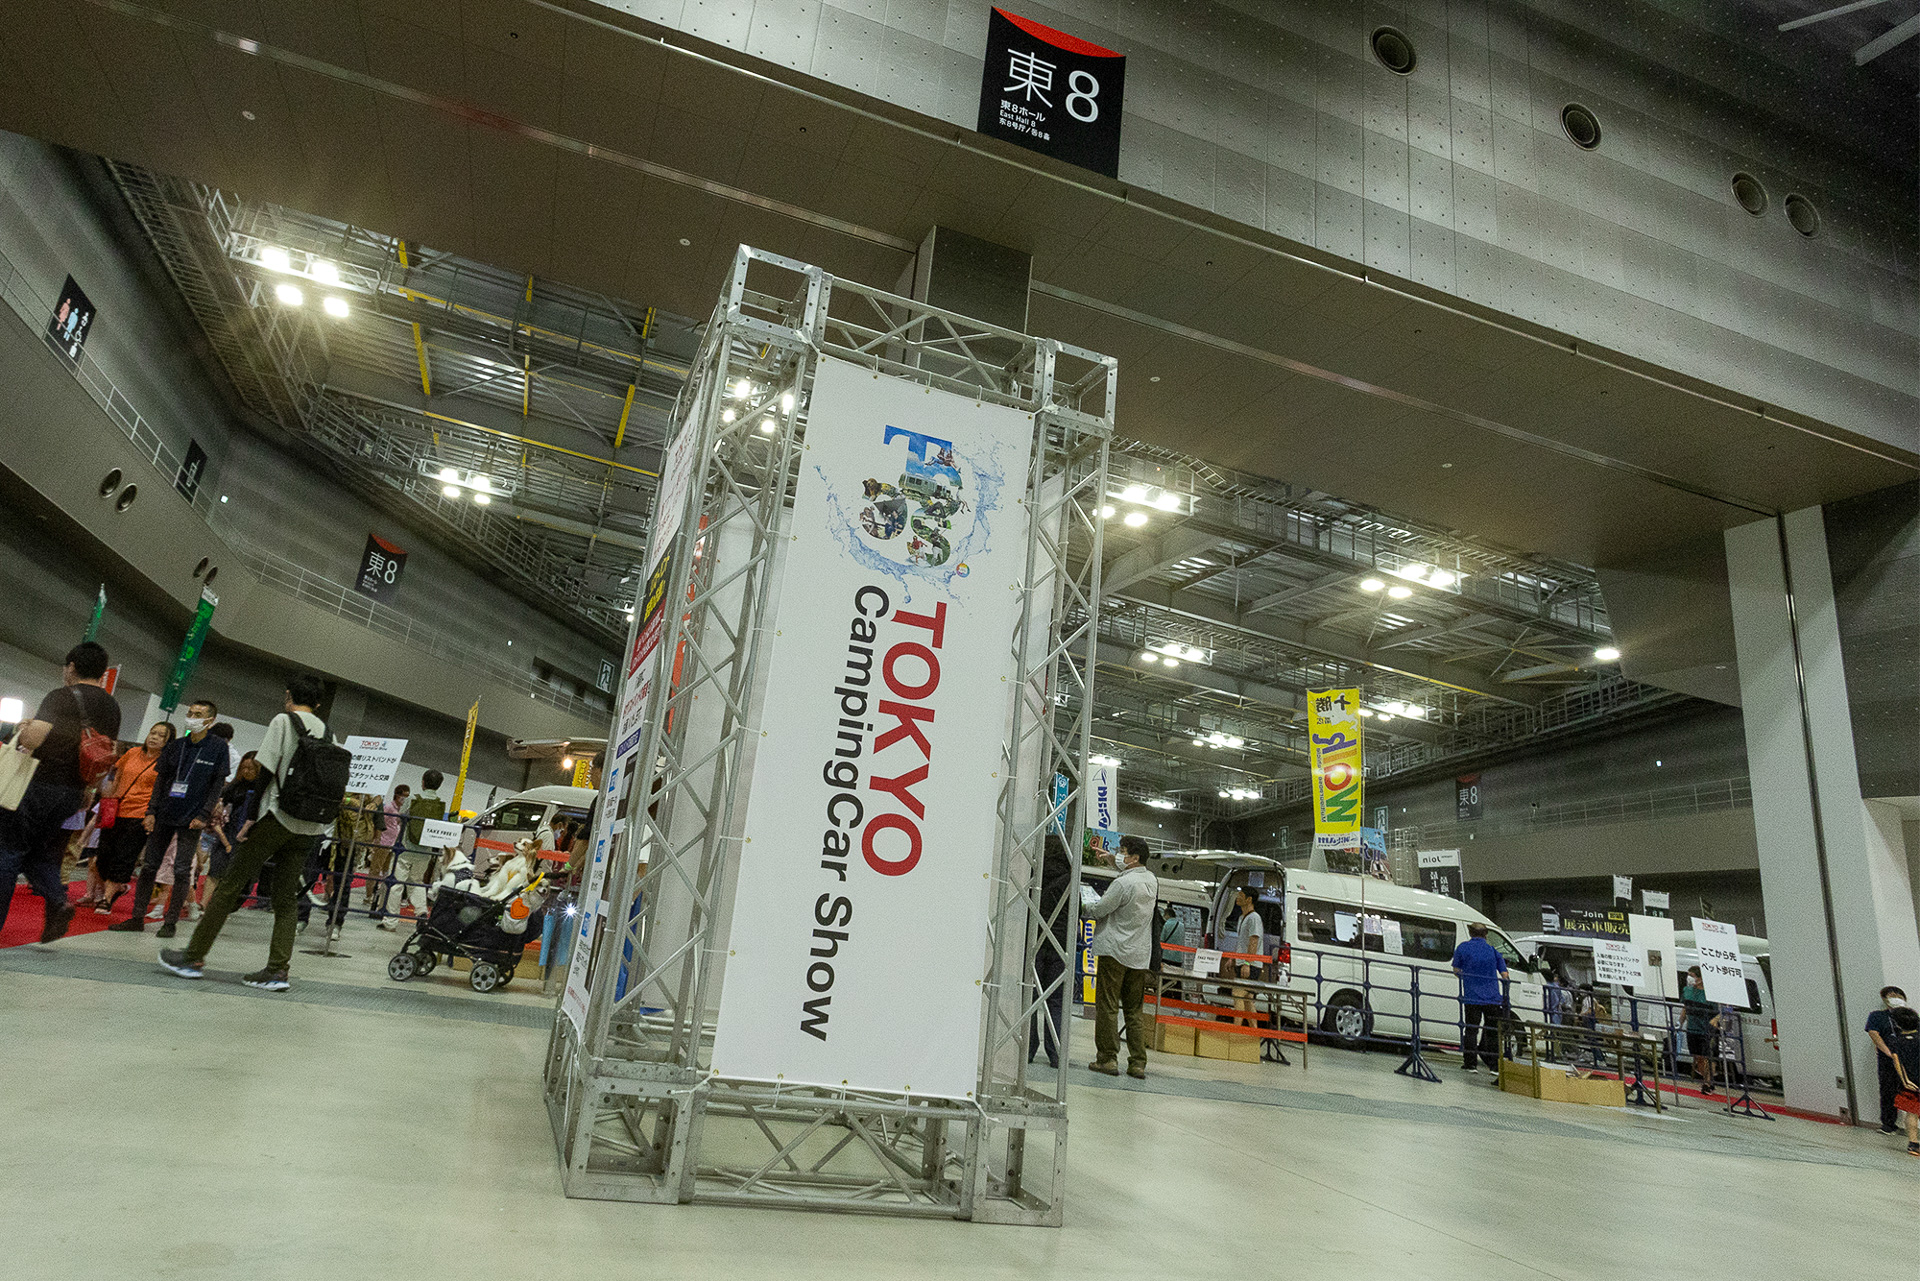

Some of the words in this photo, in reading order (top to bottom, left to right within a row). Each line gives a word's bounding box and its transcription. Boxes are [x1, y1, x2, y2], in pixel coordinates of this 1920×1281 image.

[999, 109, 1014, 120] East
[1015, 115, 1030, 125] Hall
[1030, 120, 1037, 128] 8
[1000, 99, 1046, 122] 東8ホール
[821, 585, 890, 882] CampingCar
[862, 602, 947, 876] TOKYO
[1583, 910, 1604, 919] Join
[1701, 946, 1737, 961] ここから先
[800, 893, 853, 1042] Show
